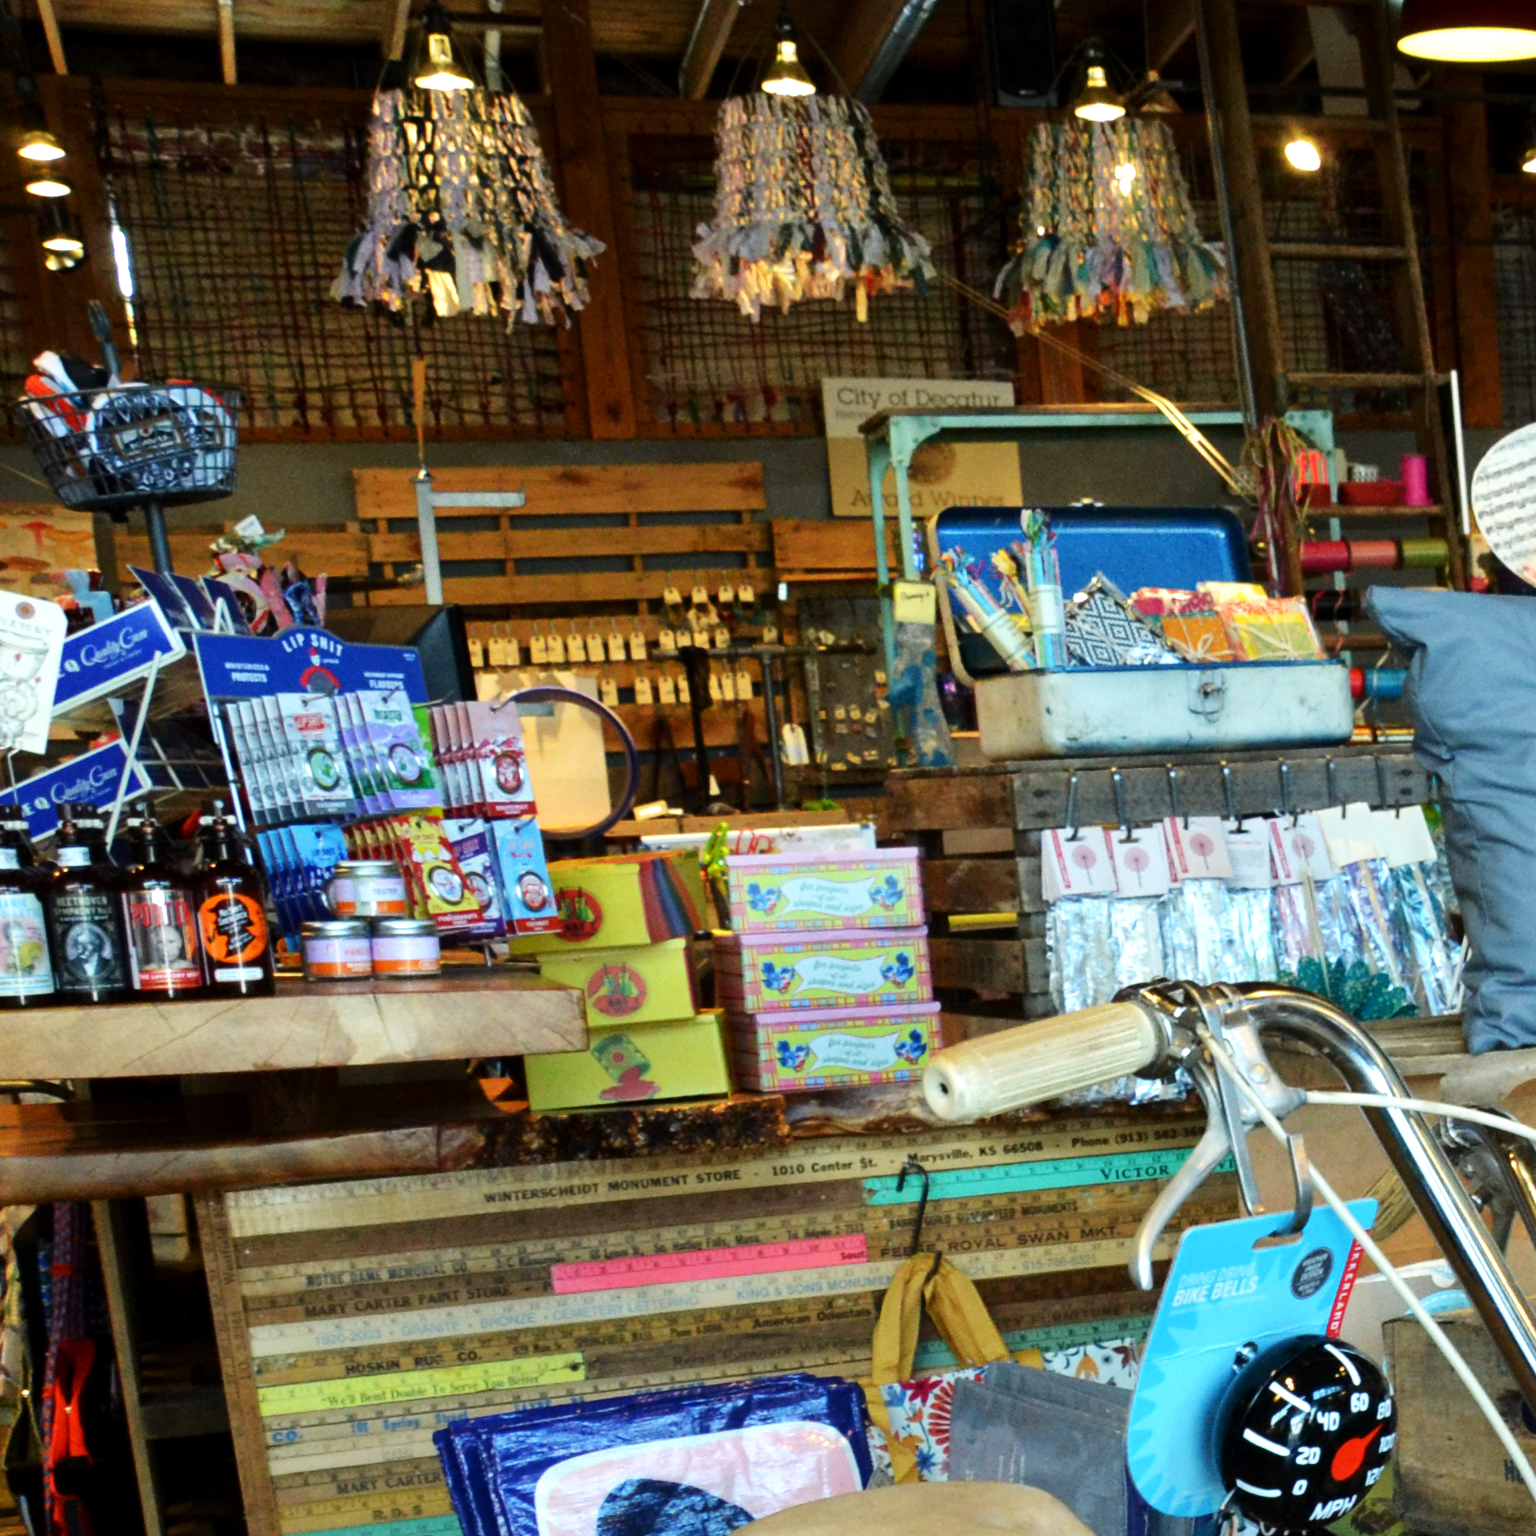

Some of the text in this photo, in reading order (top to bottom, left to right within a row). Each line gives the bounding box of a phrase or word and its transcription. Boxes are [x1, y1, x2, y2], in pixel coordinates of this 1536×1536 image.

[837, 387, 1000, 409] City of Decatur
[281, 633, 343, 657] LIP SHIT
[484, 1181, 600, 1205] WINTERSCHEIDT
[608, 1174, 689, 1193] MONUMENT
[695, 1169, 742, 1184] STORE
[772, 1163, 805, 1177] 1010
[811, 1160, 853, 1174] Center
[907, 1147, 973, 1165] Marysville,
[979, 1145, 997, 1157] KS
[1002, 1141, 1044, 1156] 66508
[1071, 1135, 1110, 1149] Phone
[1114, 1131, 1149, 1146] (913)
[947, 1236, 1006, 1251] ROYAL
[1016, 1230, 1069, 1246] SWAN
[827, 1274, 892, 1291] MONUMEN
[1171, 1276, 1260, 1308] BIKE BELLS
[304, 1303, 347, 1318] MARY
[417, 1291, 459, 1306] PAINT
[345, 1360, 400, 1376] HOSKIN
[752, 1312, 811, 1330] American
[1349, 1391, 1370, 1414] 60
[1316, 1410, 1341, 1433] 40
[1295, 1446, 1322, 1466] 20
[336, 1471, 444, 1495] MARY CARTER
[1291, 1478, 1308, 1497] 0
[1308, 1493, 1358, 1523] MPH
